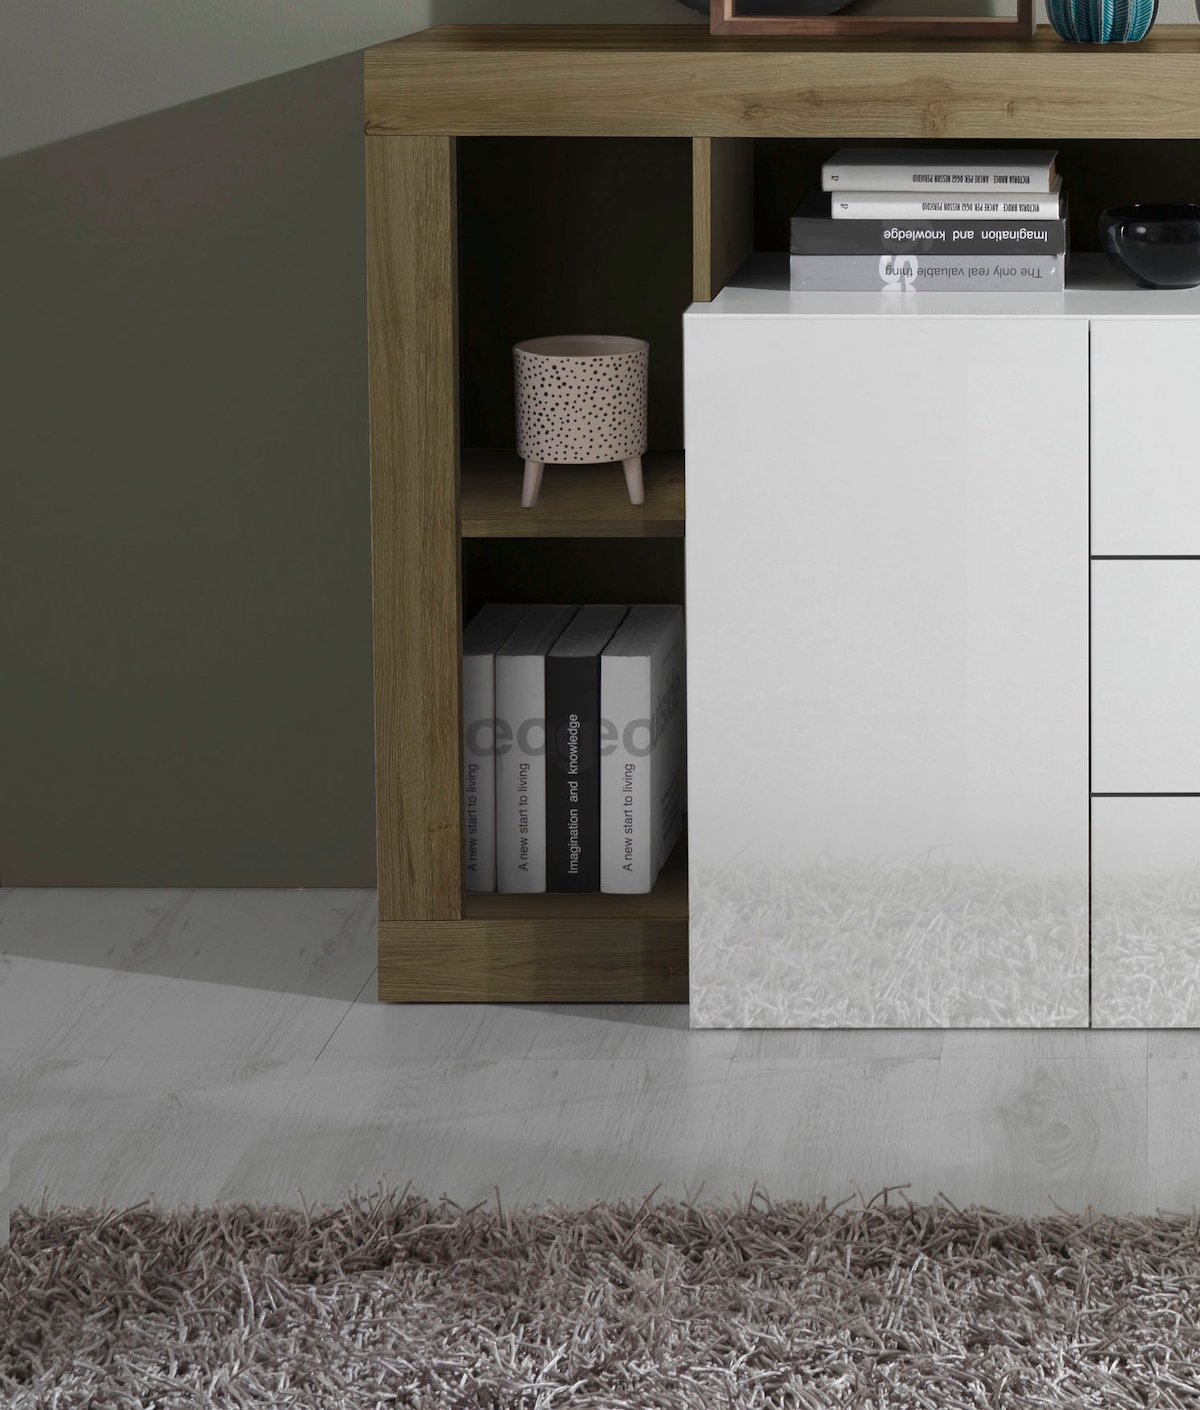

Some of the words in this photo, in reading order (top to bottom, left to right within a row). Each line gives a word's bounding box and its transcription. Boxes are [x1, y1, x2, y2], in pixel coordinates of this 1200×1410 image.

[964, 174, 973, 184] PER
[975, 174, 989, 184] ANCHE
[1009, 174, 1030, 184] VICTORIA
[974, 202, 983, 212] PER
[984, 202, 998, 212] ANCHE
[1019, 202, 1039, 212] VICTORIA
[883, 227, 946, 242] knowledge
[952, 229, 975, 242] and
[981, 228, 1048, 242] Imagination
[884, 264, 914, 277] thing
[917, 266, 964, 278] valuable
[967, 267, 990, 279] real
[992, 265, 1017, 279] only
[1020, 267, 1043, 279] The
[567, 713, 582, 775] knowledge
[465, 763, 480, 793] living
[516, 763, 531, 792] living
[621, 763, 636, 793] living
[567, 780, 579, 803] and
[467, 795, 478, 807] to
[518, 795, 529, 806] to
[623, 795, 633, 807] to
[467, 809, 478, 834] start
[518, 808, 529, 834] start
[623, 809, 633, 834] start
[567, 808, 582, 874] Imagination
[469, 837, 478, 860] new
[519, 836, 529, 860] new
[624, 837, 633, 860] new
[466, 862, 478, 872] A
[518, 862, 529, 871] A
[622, 862, 633, 872] A
